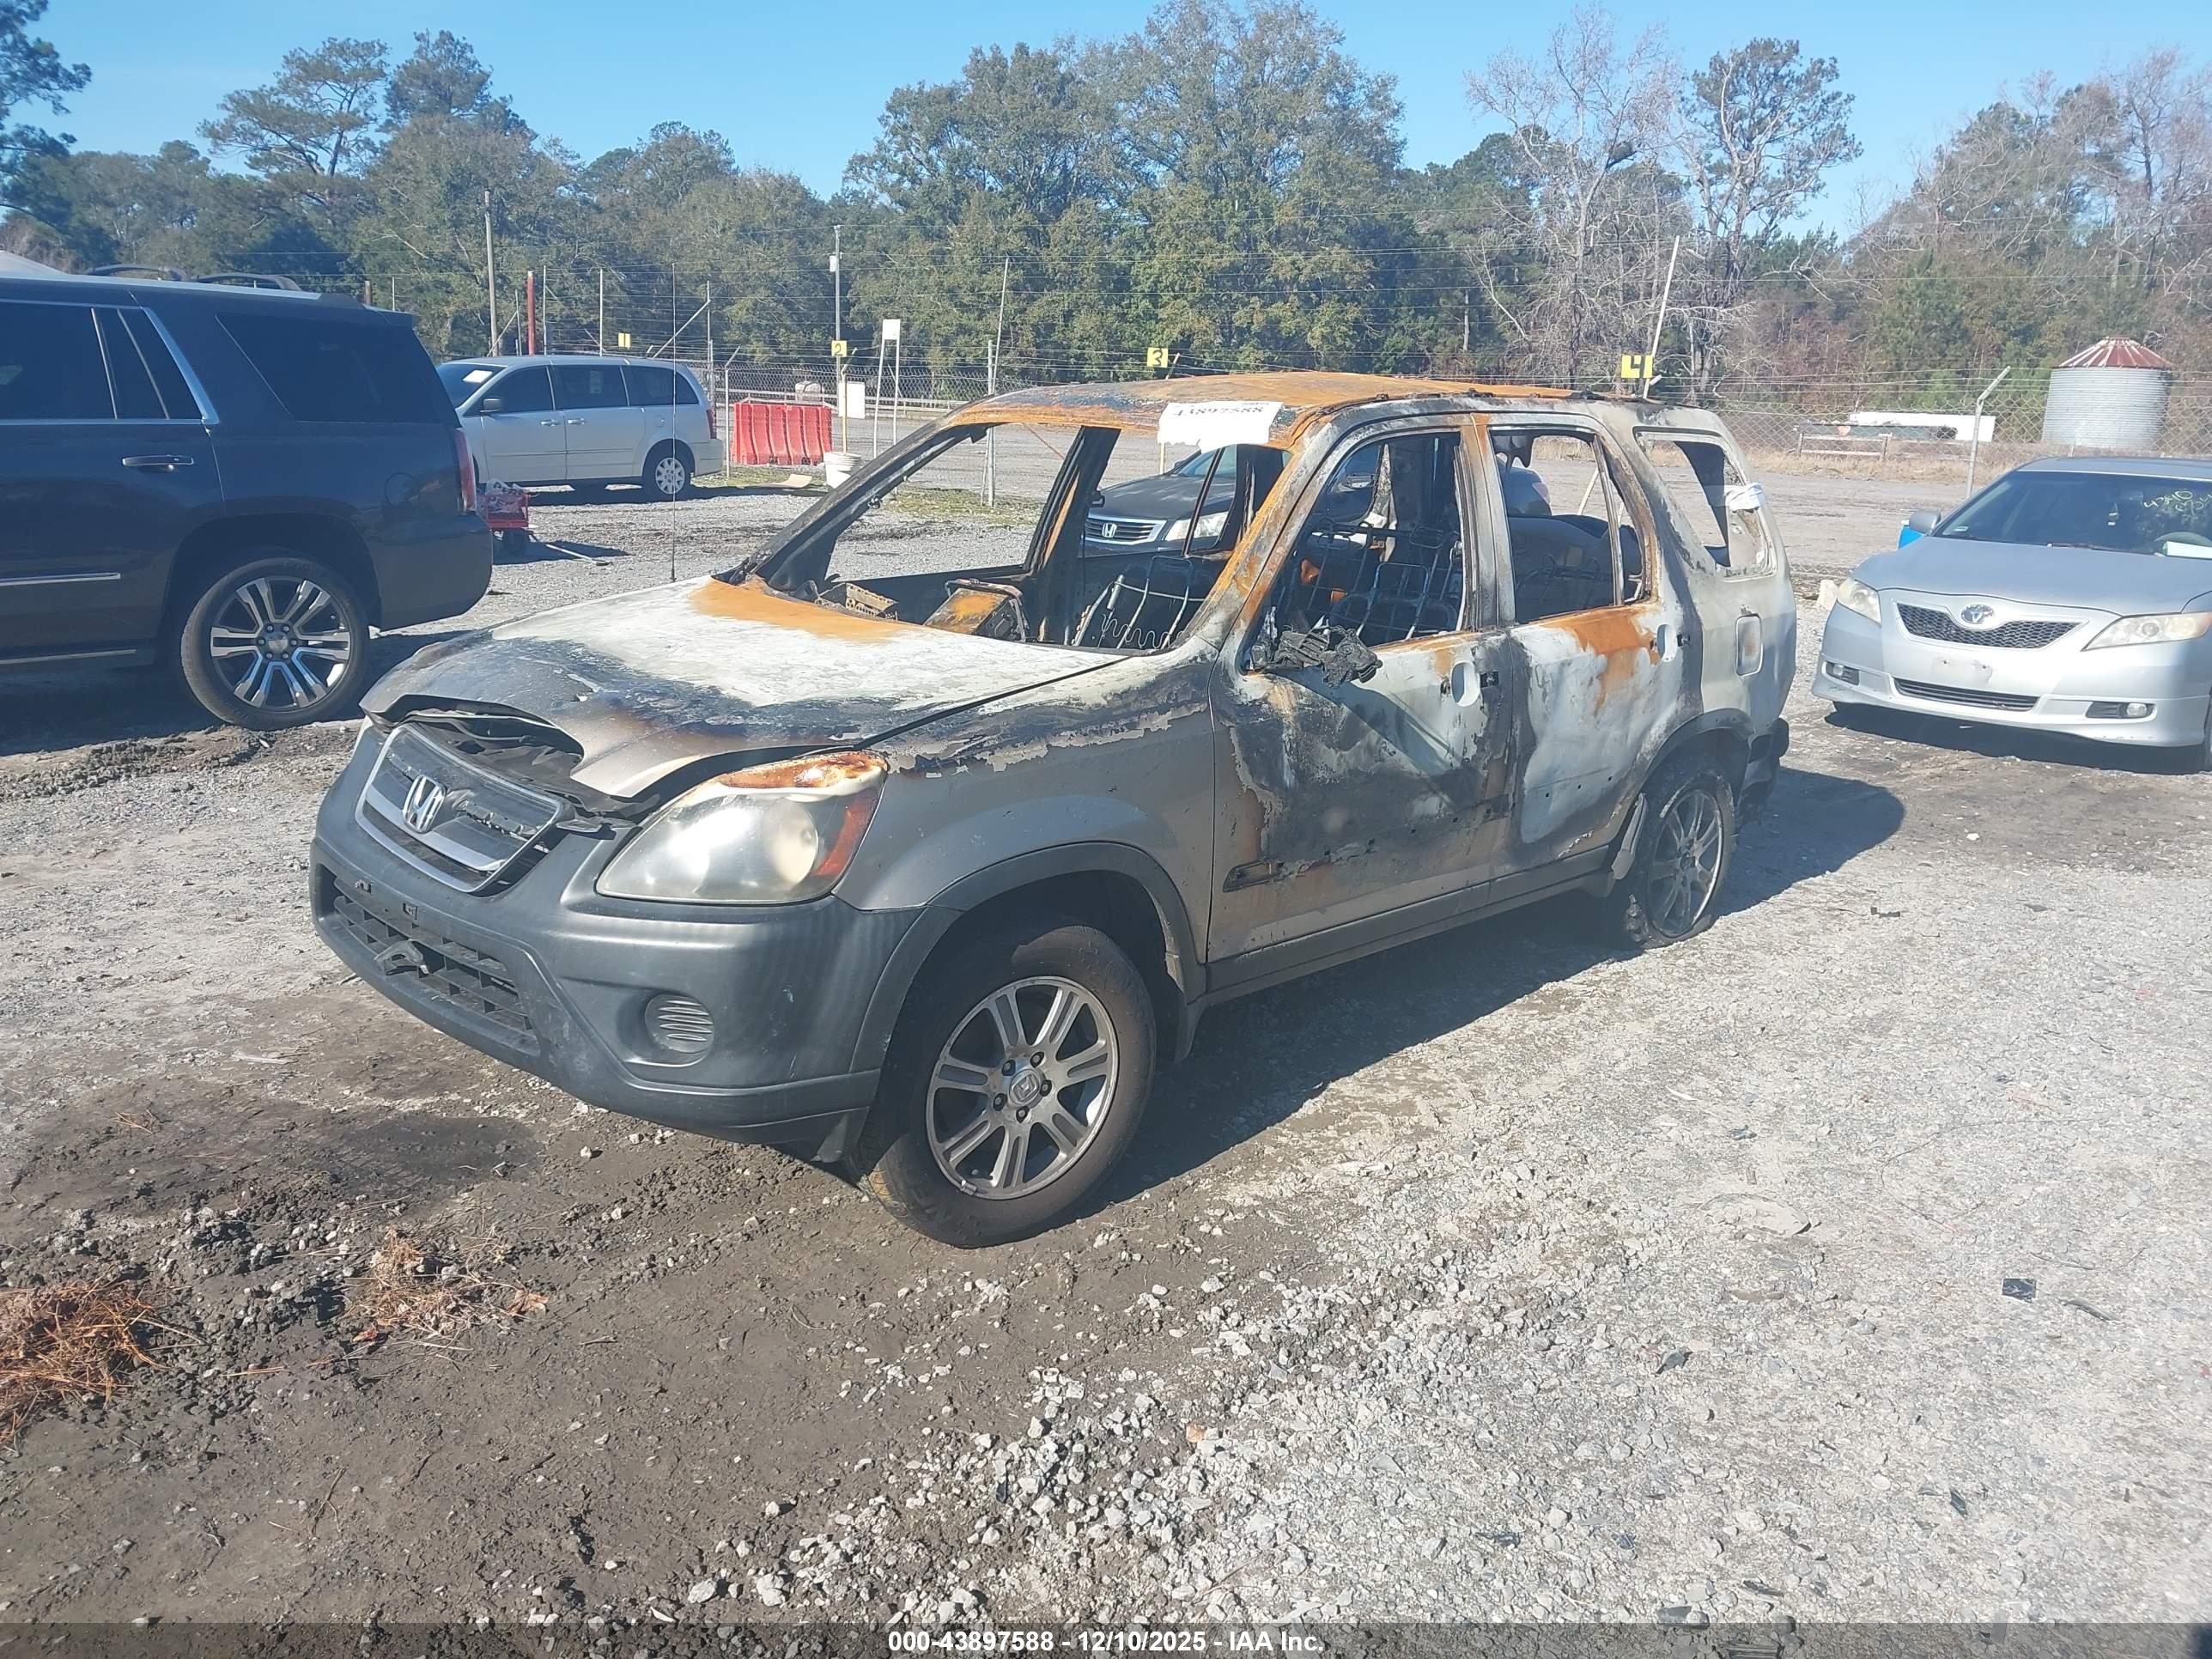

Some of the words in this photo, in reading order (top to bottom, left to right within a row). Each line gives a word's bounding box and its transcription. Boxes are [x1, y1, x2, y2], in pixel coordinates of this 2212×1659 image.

[834, 343, 843, 356] 2
[1152, 349, 1163, 367] 3
[1631, 355, 1645, 378] 4
